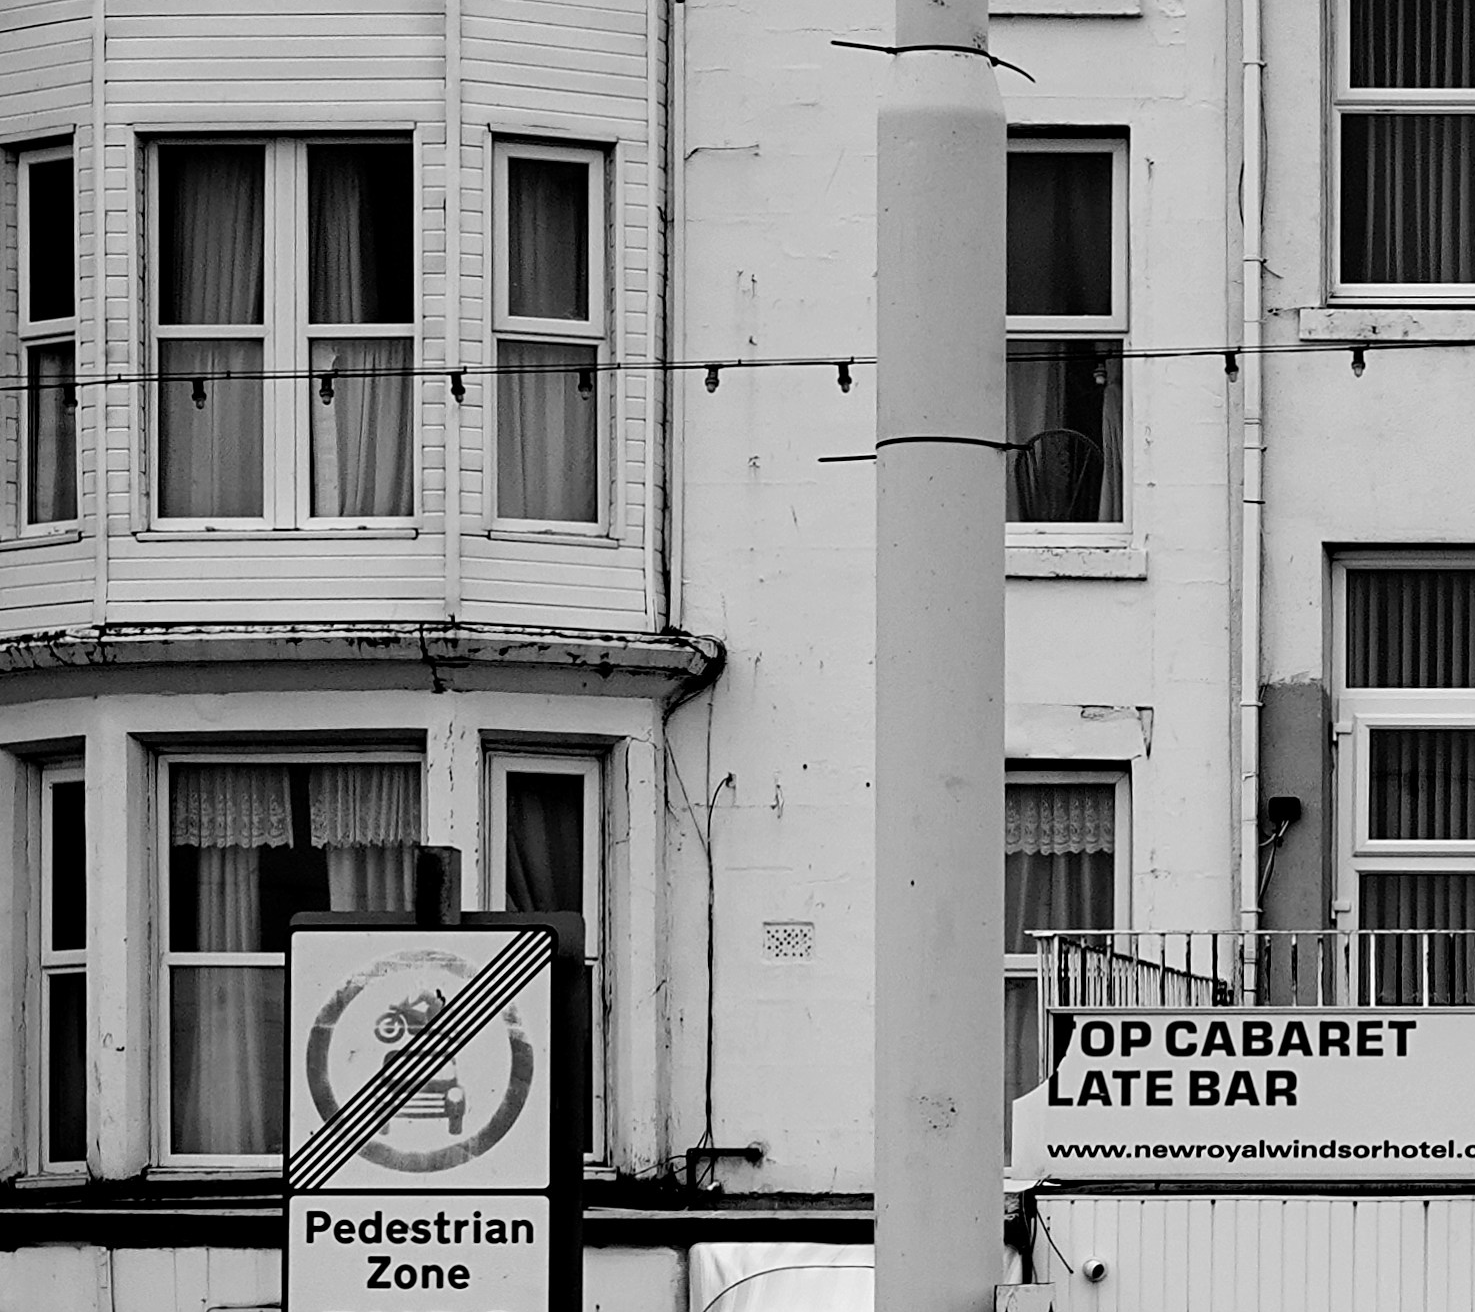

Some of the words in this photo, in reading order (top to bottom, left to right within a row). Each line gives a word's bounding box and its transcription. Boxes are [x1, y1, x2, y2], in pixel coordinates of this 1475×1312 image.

[1072, 1021, 1151, 1057] OP
[1166, 1021, 1416, 1056] CABARET
[1048, 1071, 1172, 1106] LATE
[1190, 1071, 1297, 1106] BAR
[307, 1211, 533, 1244] Pedestrian
[367, 1256, 470, 1289] Zone
